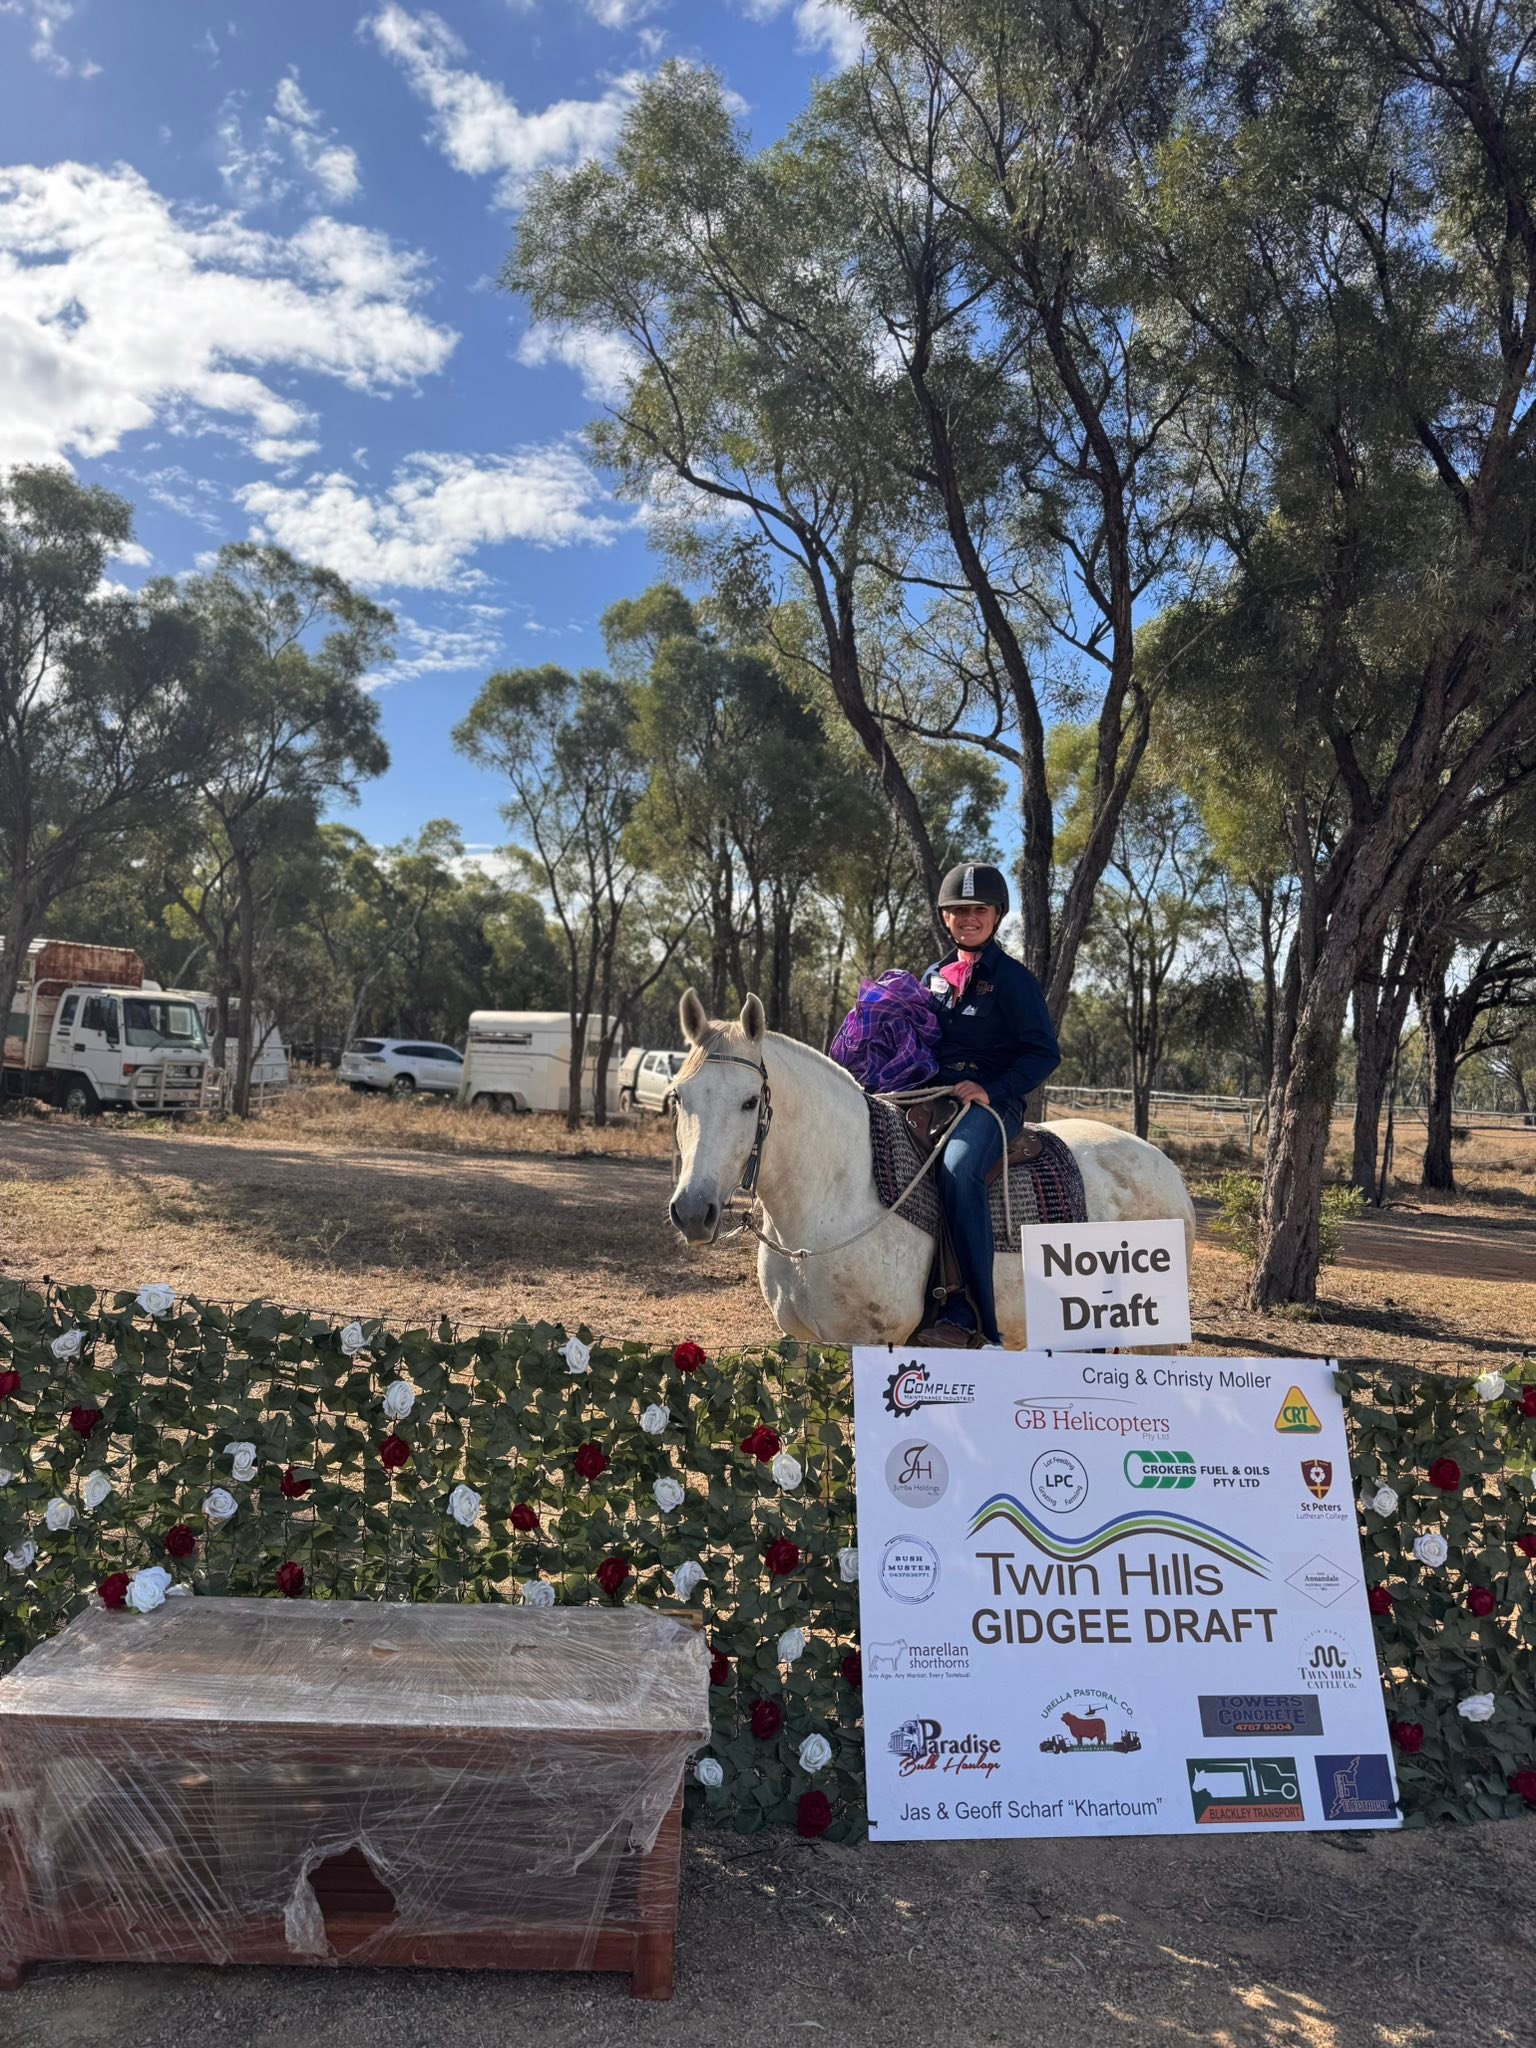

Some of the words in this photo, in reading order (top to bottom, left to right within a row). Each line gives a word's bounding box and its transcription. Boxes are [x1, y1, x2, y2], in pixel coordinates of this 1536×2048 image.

[1041, 1240, 1171, 1277] Novice
[1060, 1293, 1159, 1331] Draft
[1082, 1367, 1129, 1388] Craig
[1135, 1369, 1148, 1385] &
[1153, 1369, 1213, 1391] Christy
[1219, 1371, 1271, 1388] Moller
[903, 1379, 975, 1395] COMPLETE
[1282, 1406, 1308, 1424] CRT
[1015, 1410, 1046, 1430] GB
[1053, 1411, 1170, 1436] Helicopters
[1142, 1433, 1156, 1441] Pty
[1053, 1457, 1075, 1470] Feeding
[1142, 1465, 1197, 1474] CROKERS
[1200, 1466, 1228, 1475] FUEL
[1232, 1466, 1240, 1475] &
[1244, 1466, 1270, 1475] OILS
[1045, 1474, 1073, 1488] LPC
[1213, 1478, 1235, 1487] PTY
[1239, 1479, 1260, 1488] LTD
[914, 1484, 940, 1493] Holdings
[1038, 1486, 1057, 1506] Grazing
[1064, 1485, 1083, 1505] Farming
[1301, 1502, 1311, 1511] St
[1312, 1503, 1341, 1511] Peters
[1325, 1513, 1348, 1521] College
[975, 1552, 1100, 1595] Twin
[1118, 1553, 1224, 1596] Hills
[972, 1608, 1132, 1644] GIDGEE
[1144, 1608, 1278, 1643] DRAFT
[909, 1642, 969, 1656] marellan
[909, 1657, 969, 1669] shorthorns
[1297, 1667, 1328, 1680] TWIN
[1330, 1667, 1362, 1680] HILLS
[1307, 1681, 1342, 1689] CATTLE
[1041, 1692, 1072, 1719] URELLA
[1073, 1688, 1118, 1704] PASTORAL
[1216, 1696, 1303, 1707] TOWERS
[1218, 1709, 1306, 1725] CONCRETE
[1235, 1723, 1260, 1731] 4787
[1263, 1723, 1292, 1731] 9304
[918, 1718, 1001, 1757] Paradise
[899, 1753, 940, 1777] Bulk
[943, 1752, 1001, 1779] Haulage
[900, 1803, 931, 1821] Jas
[936, 1802, 949, 1819] &
[955, 1801, 1002, 1819] Geoff
[1008, 1800, 1064, 1818] Scharf
[1209, 1808, 1251, 1819] BLACKLEY
[1252, 1806, 1301, 1818] TRANSPORT
